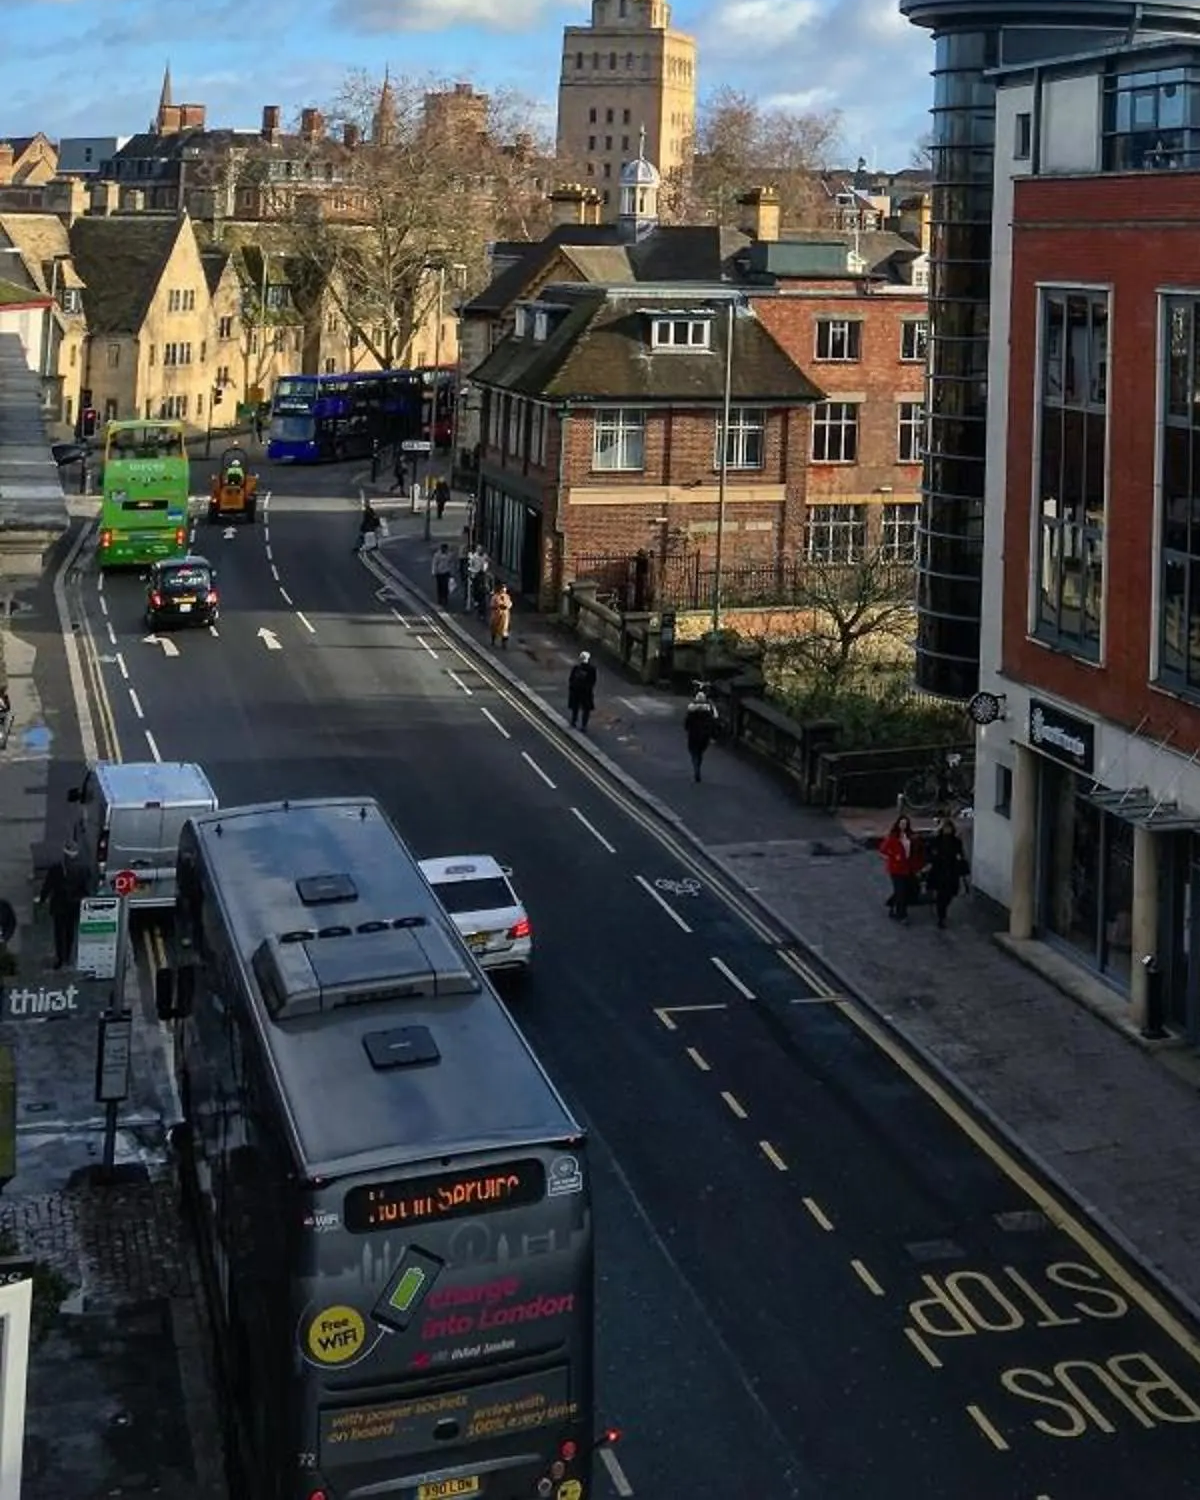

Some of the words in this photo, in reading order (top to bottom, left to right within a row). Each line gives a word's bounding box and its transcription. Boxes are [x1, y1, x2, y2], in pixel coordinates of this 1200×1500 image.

[478, 1294, 575, 1326] London
[909, 1262, 1127, 1337] STOP
[321, 1318, 348, 1332] Free
